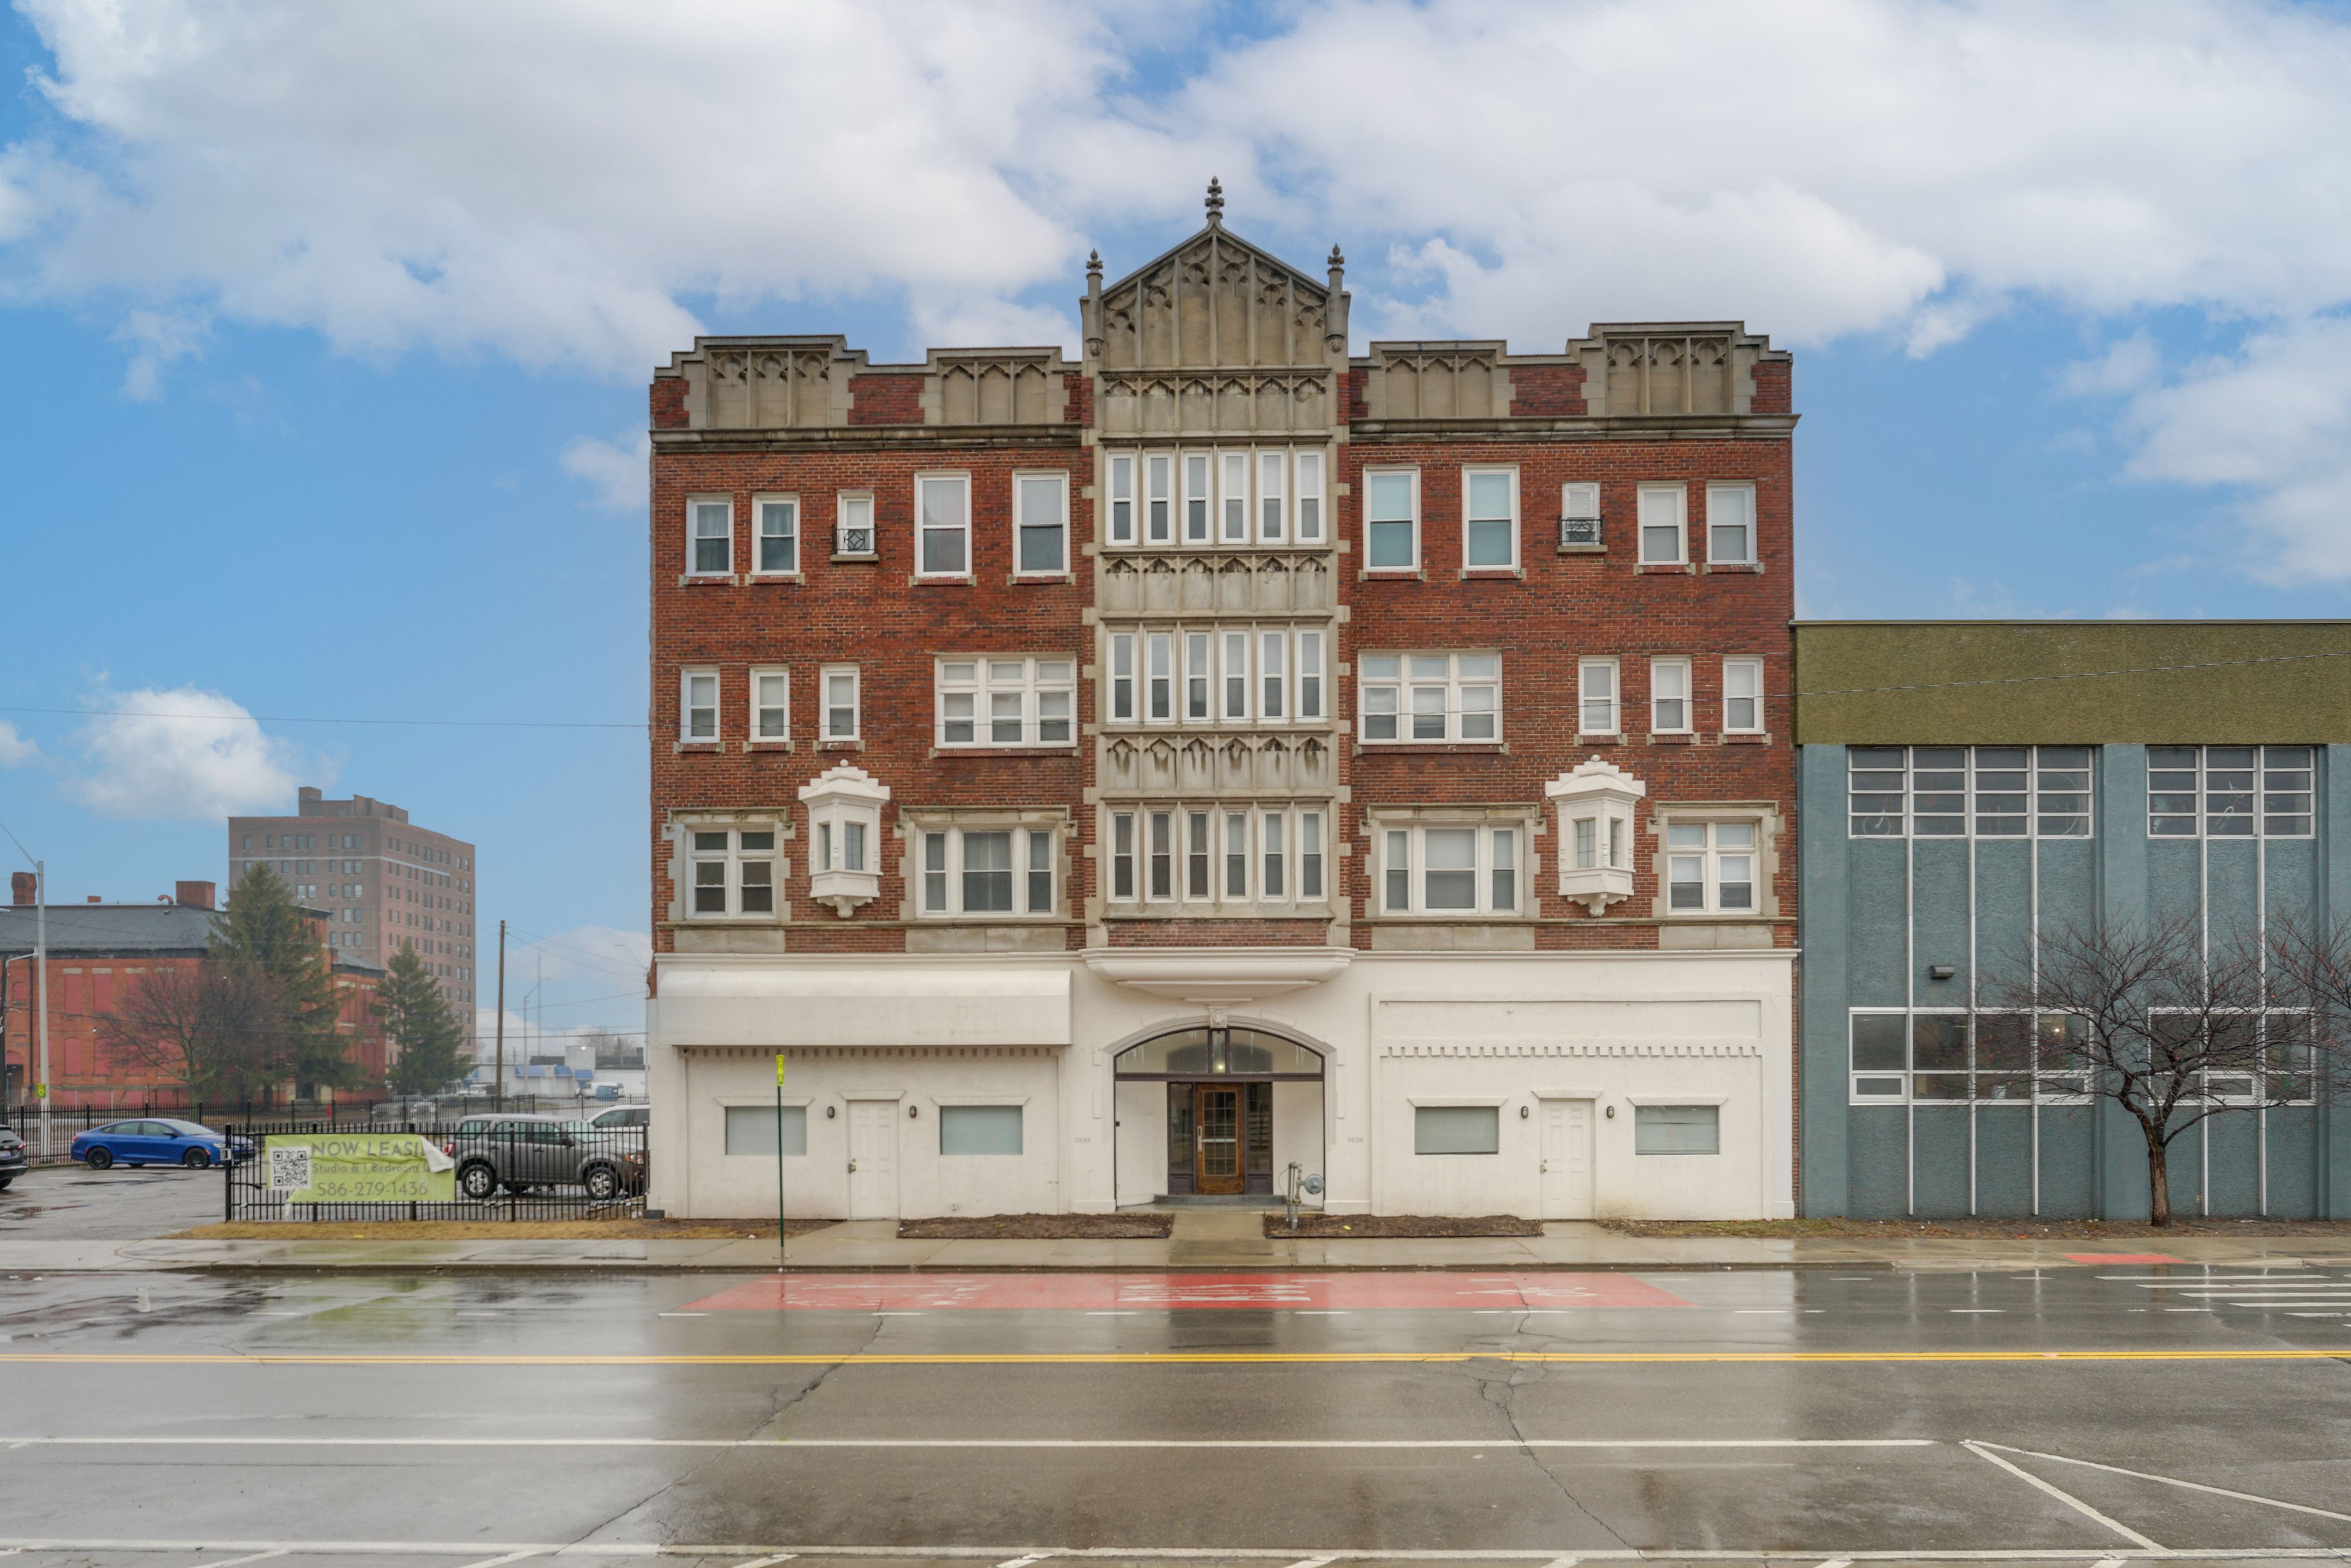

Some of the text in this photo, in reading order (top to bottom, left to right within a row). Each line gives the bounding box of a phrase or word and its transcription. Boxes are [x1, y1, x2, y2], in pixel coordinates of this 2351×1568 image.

[312, 1141, 425, 1156] NOW LEASI
[313, 1163, 347, 1173] Studio
[351, 1163, 358, 1172] &
[372, 1162, 418, 1172] Bedroom
[318, 1182, 428, 1196] 586-279-1436
